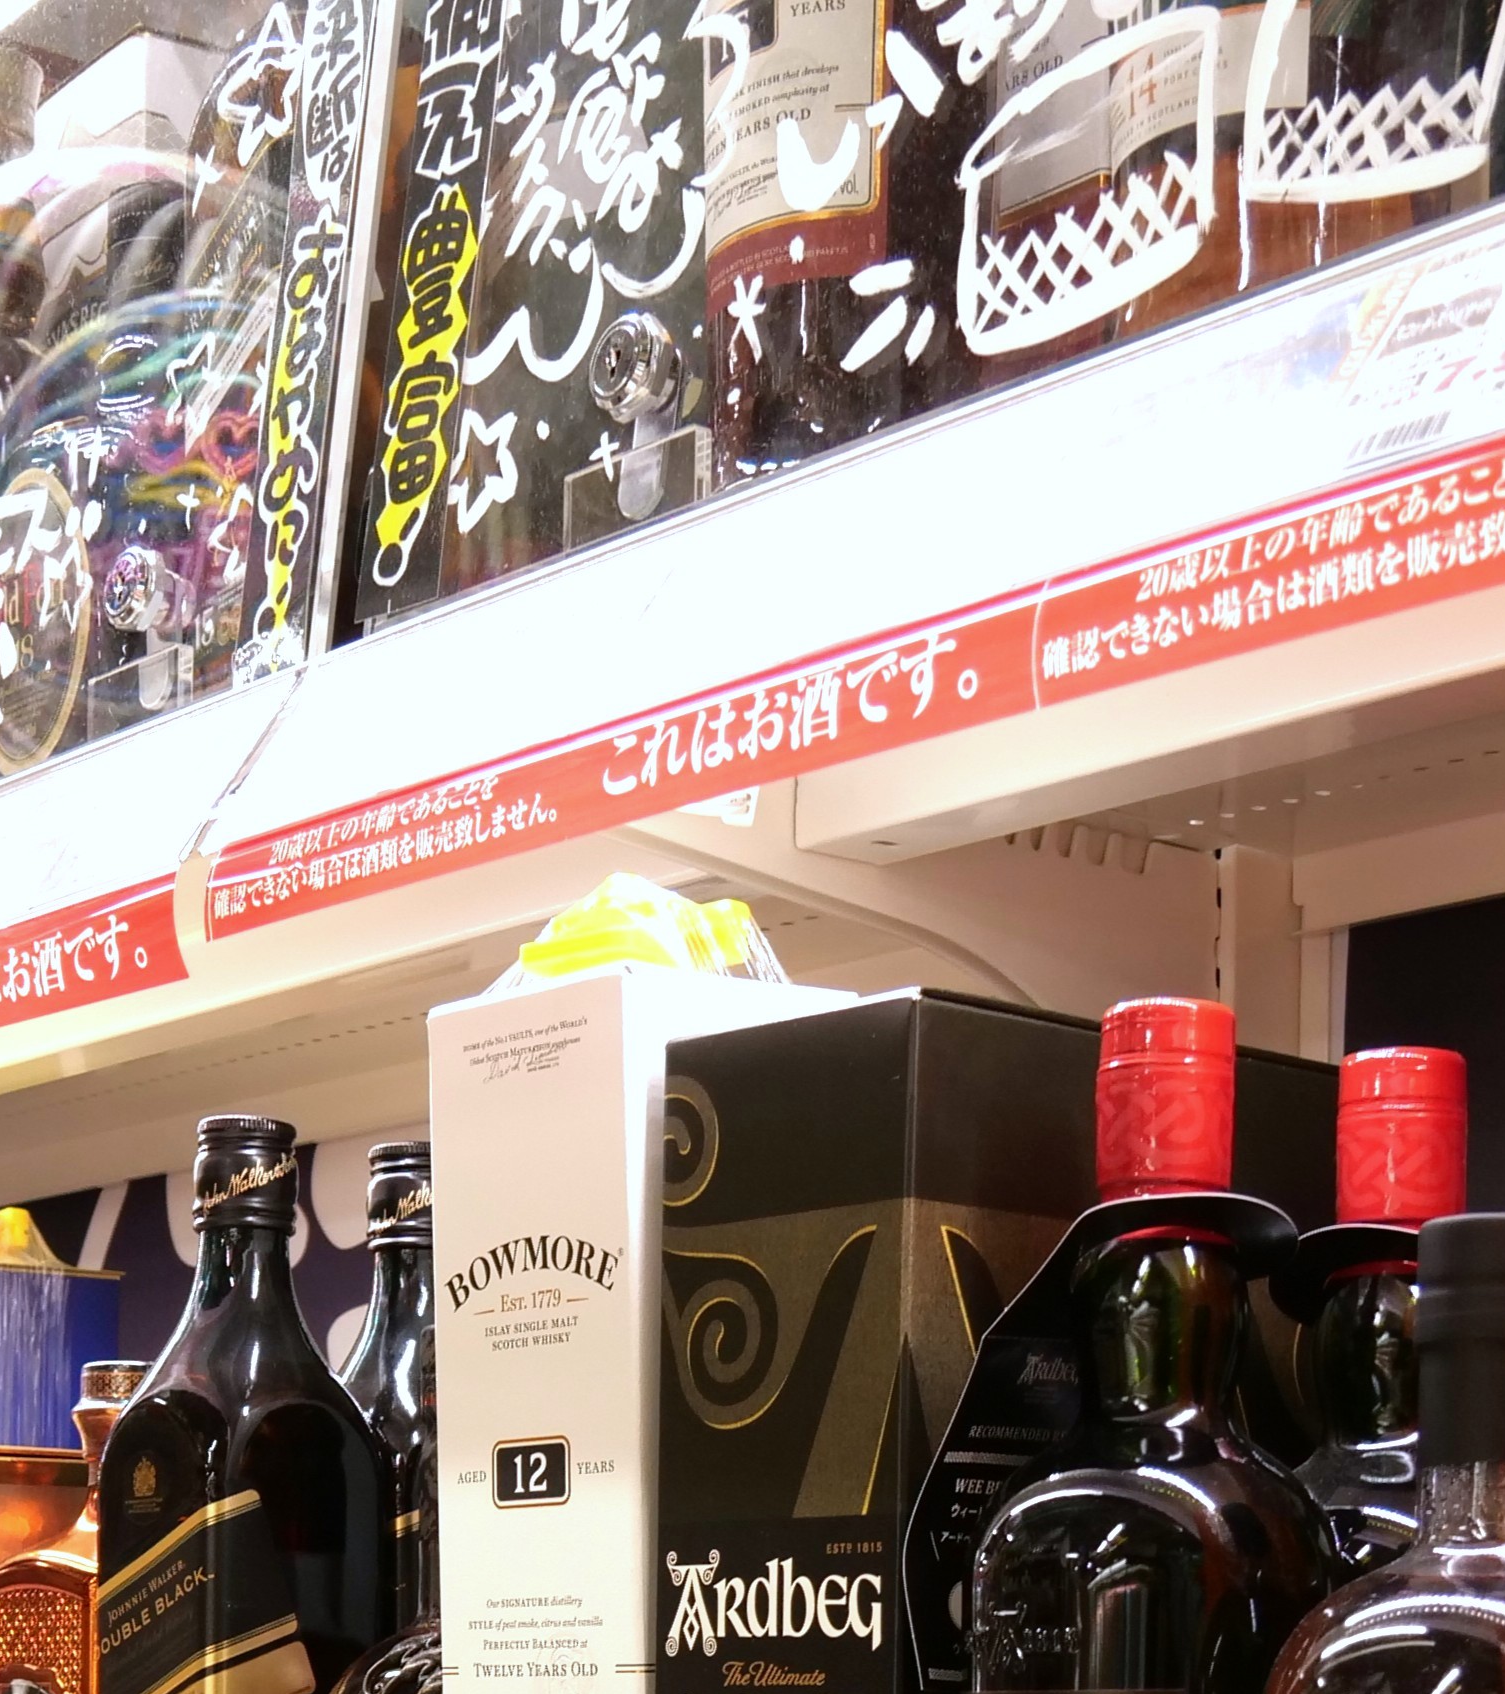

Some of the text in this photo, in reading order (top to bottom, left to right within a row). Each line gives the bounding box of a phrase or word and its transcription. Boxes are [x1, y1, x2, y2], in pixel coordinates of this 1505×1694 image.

[602, 637, 979, 797] これはお酒です。
[268, 772, 500, 865] 20歳以上の年齢であることを
[212, 793, 558, 921] 確認できない場合は酒類を販売致しません。
[444, 1235, 619, 1312] BOWMORE
[531, 1288, 562, 1309] 1779
[484, 1315, 579, 1338] ISLAY SINGLE MALT
[492, 1332, 572, 1352] SCOTCH WHISKY
[457, 1452, 615, 1494] AGED 12 YEARS
[473, 1660, 568, 1680] TWELVE YEARS
